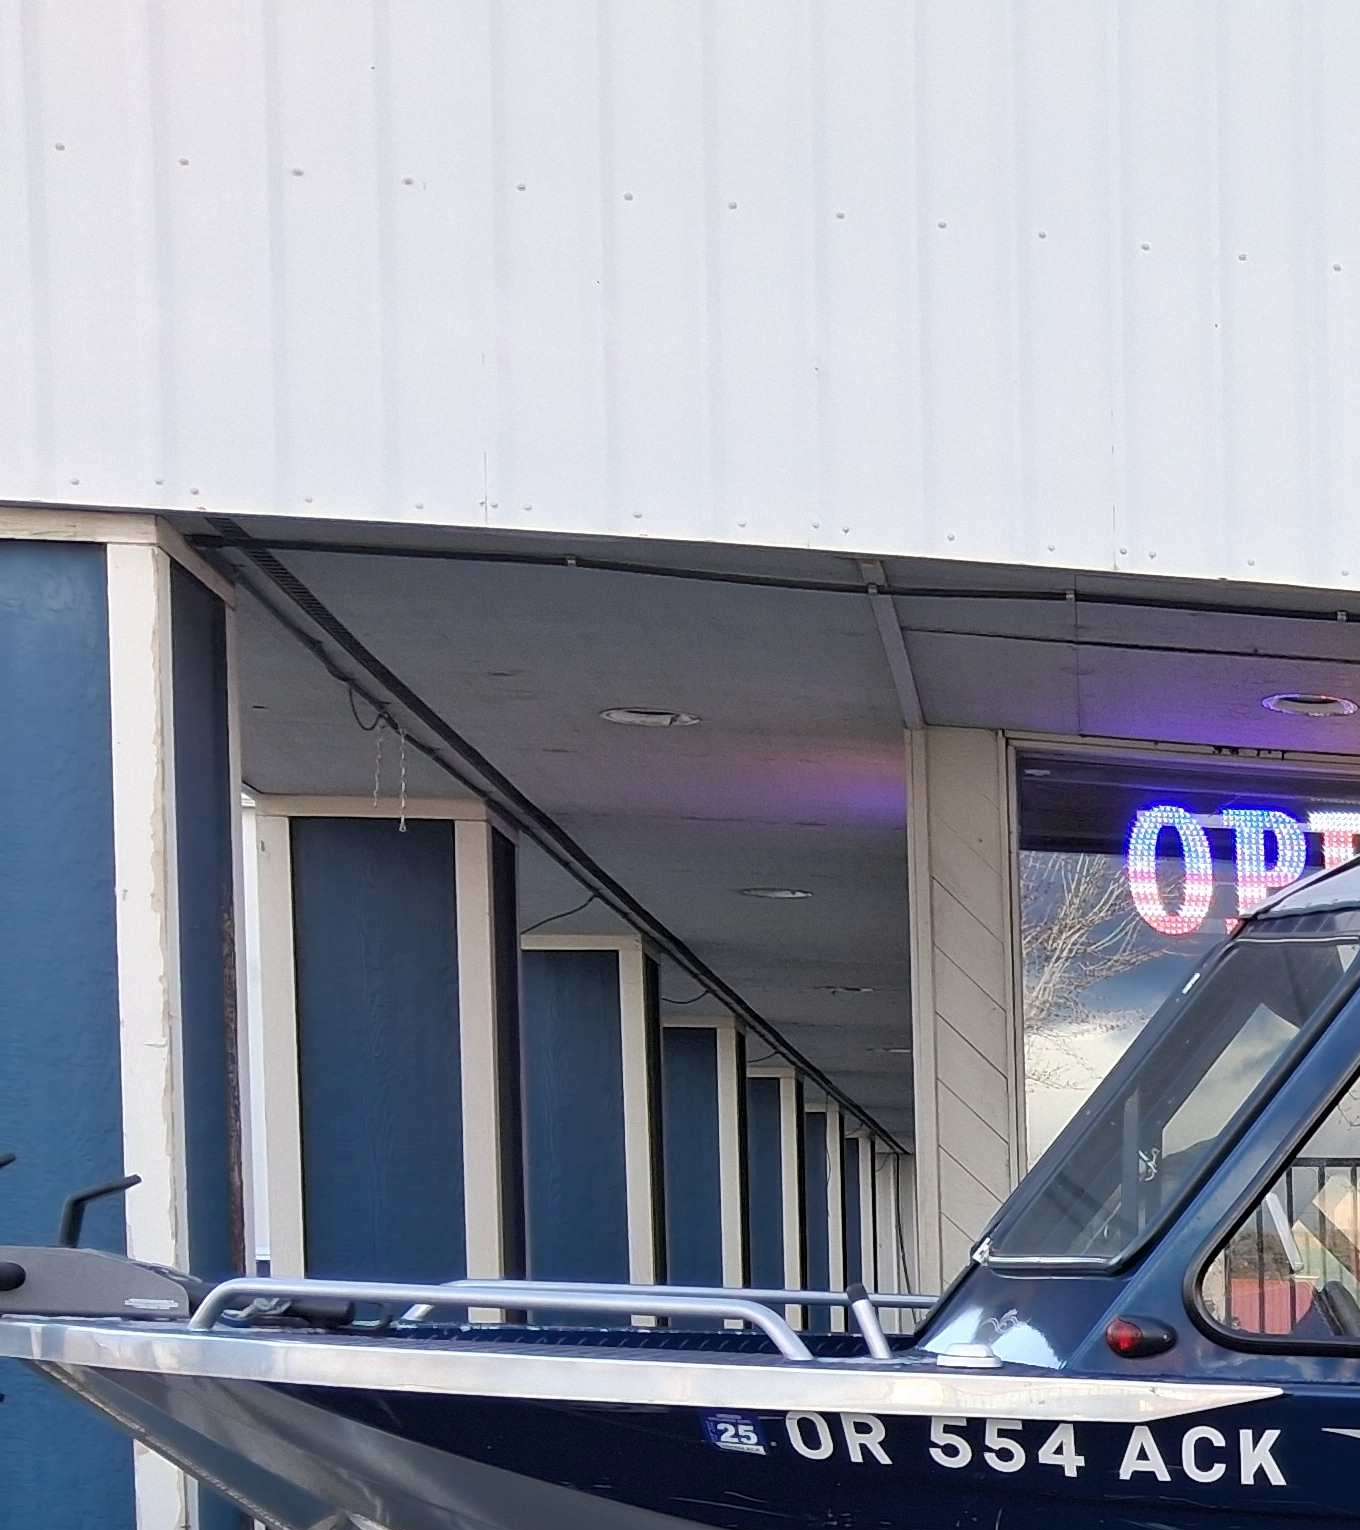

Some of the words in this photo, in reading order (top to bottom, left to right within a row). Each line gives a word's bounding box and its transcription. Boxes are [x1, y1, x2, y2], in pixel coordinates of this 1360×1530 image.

[716, 1423, 758, 1445] 25
[785, 1410, 893, 1466] OR
[929, 1415, 1086, 1478] 554
[1118, 1425, 1288, 1487] ACK
